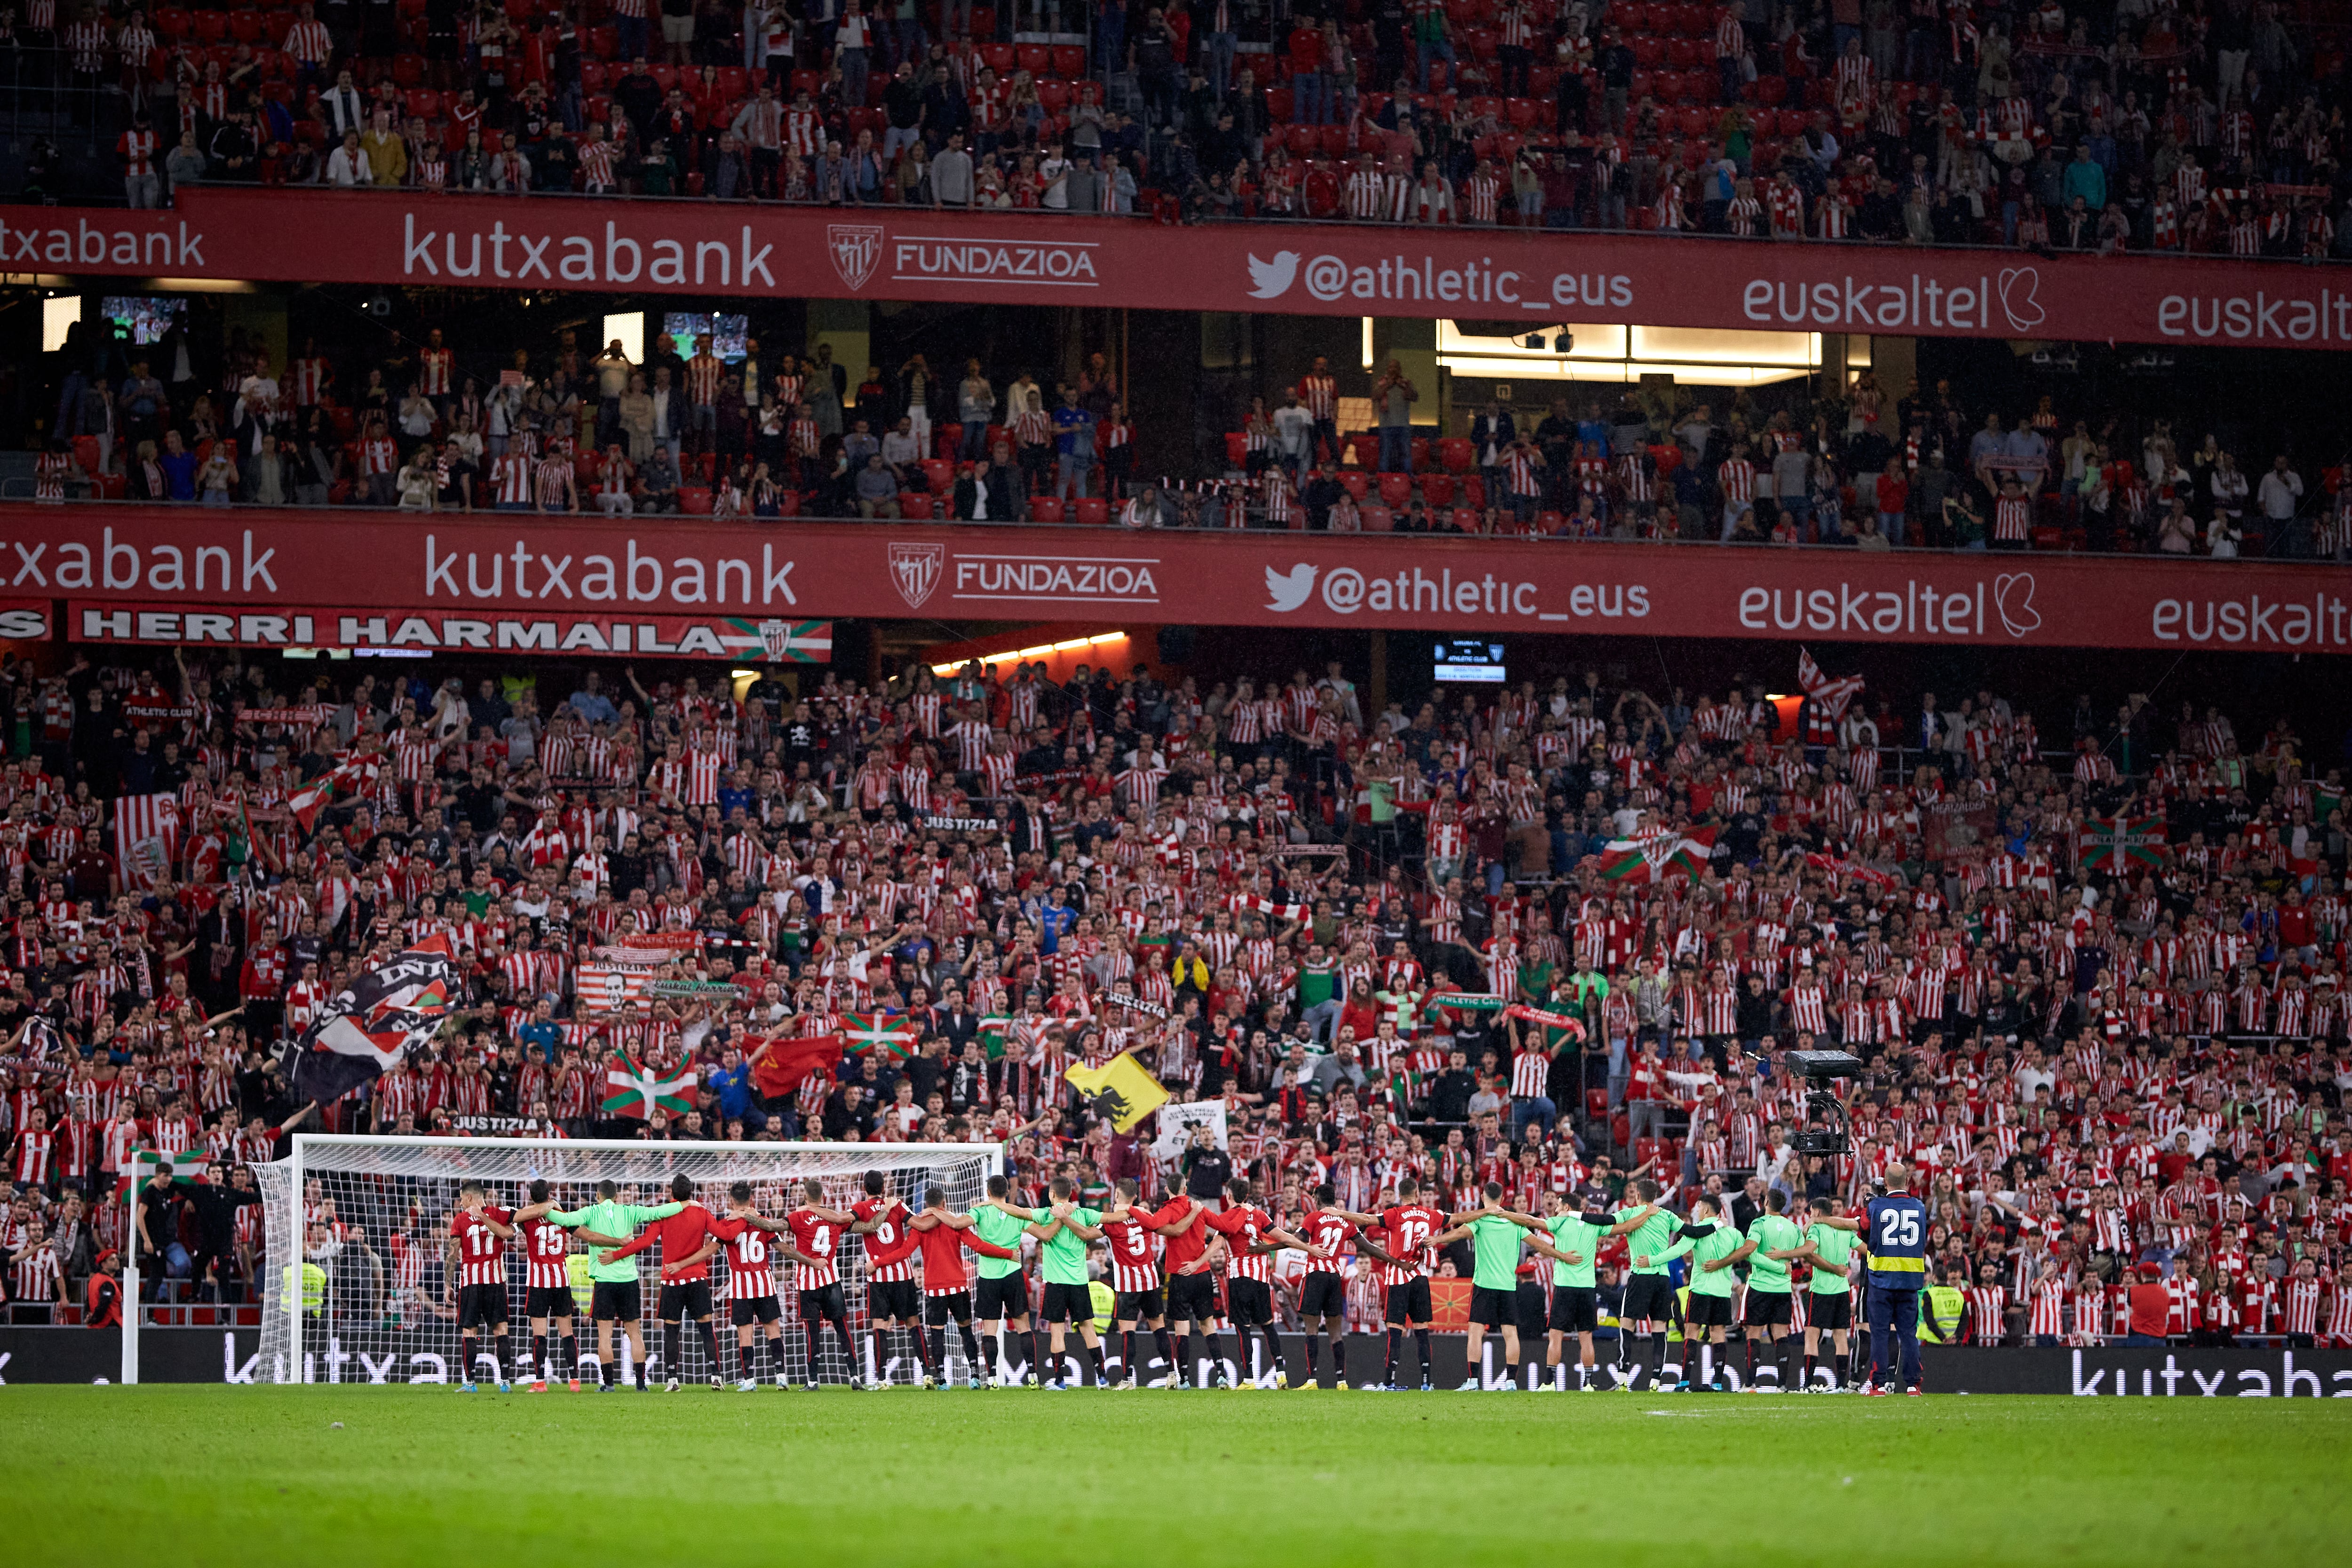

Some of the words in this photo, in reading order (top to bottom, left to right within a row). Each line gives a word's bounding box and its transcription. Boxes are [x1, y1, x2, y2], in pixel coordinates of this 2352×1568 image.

[405, 213, 776, 287] kutxabank
[897, 245, 1097, 278] FUNDAZIOA
[1304, 255, 1633, 310] @athletic_eus
[1743, 274, 1988, 328] euskaltel
[2158, 288, 2352, 342] euskalt
[426, 534, 797, 605] kutxabank
[957, 563, 1157, 594] FUNDAZIOA
[1322, 567, 1650, 621] @athletic_eus
[1740, 580, 1984, 635] euskaltel
[83, 609, 314, 644] HERRI
[340, 617, 726, 654] HARMAILA
[2153, 593, 2352, 645] euskalt
[126, 706, 168, 716] ATHLETIC
[170, 708, 193, 717] CLUB
[924, 816, 997, 831] JUSTIZIA
[625, 934, 664, 943] ATHLETIC
[667, 934, 692, 944] CLUB
[453, 1115, 538, 1131] JUSTIZIA
[467, 1224, 495, 1256] 17
[534, 1225, 563, 1256] 15
[812, 1226, 832, 1257] 4
[1127, 1226, 1146, 1256] 5
[1319, 1226, 1343, 1258] 11
[1880, 1208, 1919, 1246] 25
[735, 1231, 765, 1263] 16
